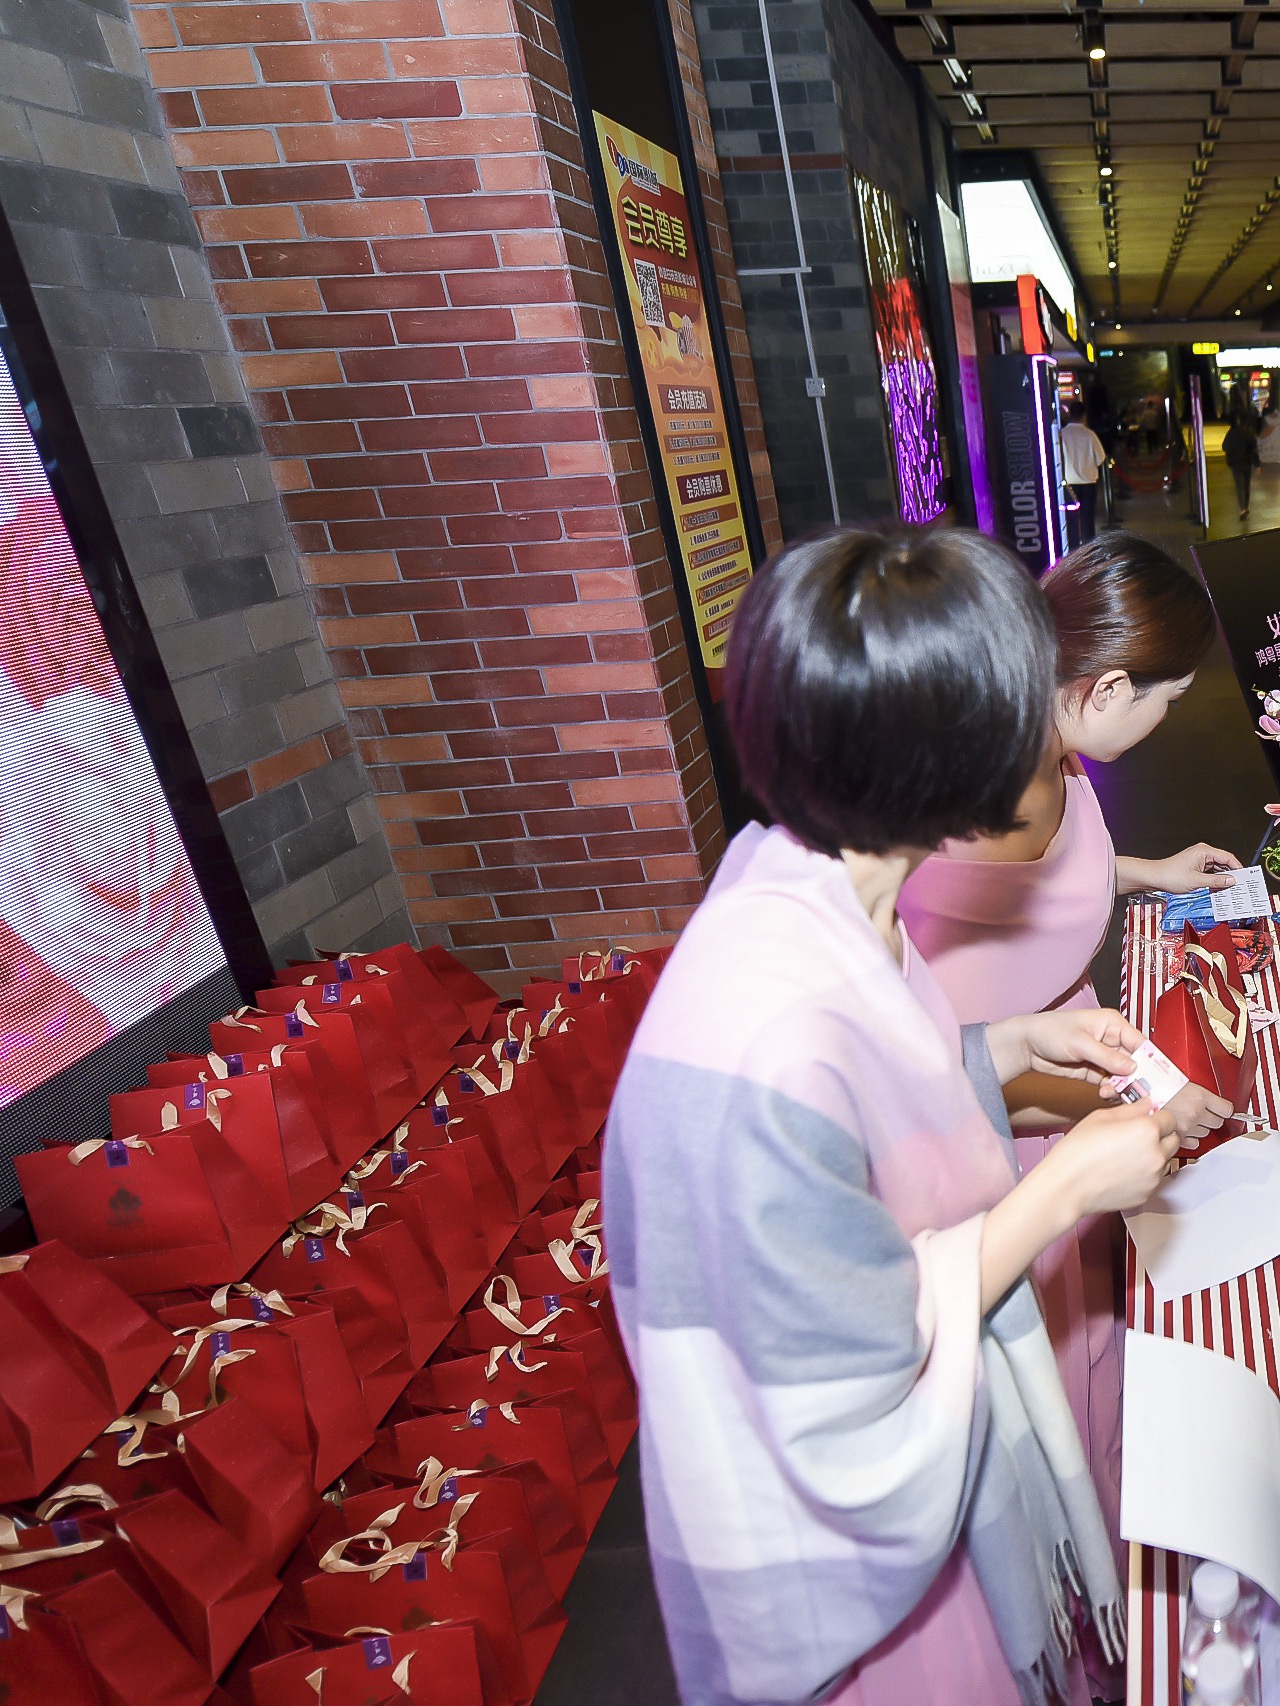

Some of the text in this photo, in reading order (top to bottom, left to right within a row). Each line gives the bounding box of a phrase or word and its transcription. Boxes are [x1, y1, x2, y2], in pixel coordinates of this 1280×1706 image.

[621, 195, 688, 258] 会员尊享
[667, 388, 708, 410] 会员充值活动
[686, 474, 723, 499] 会员购票优惠
